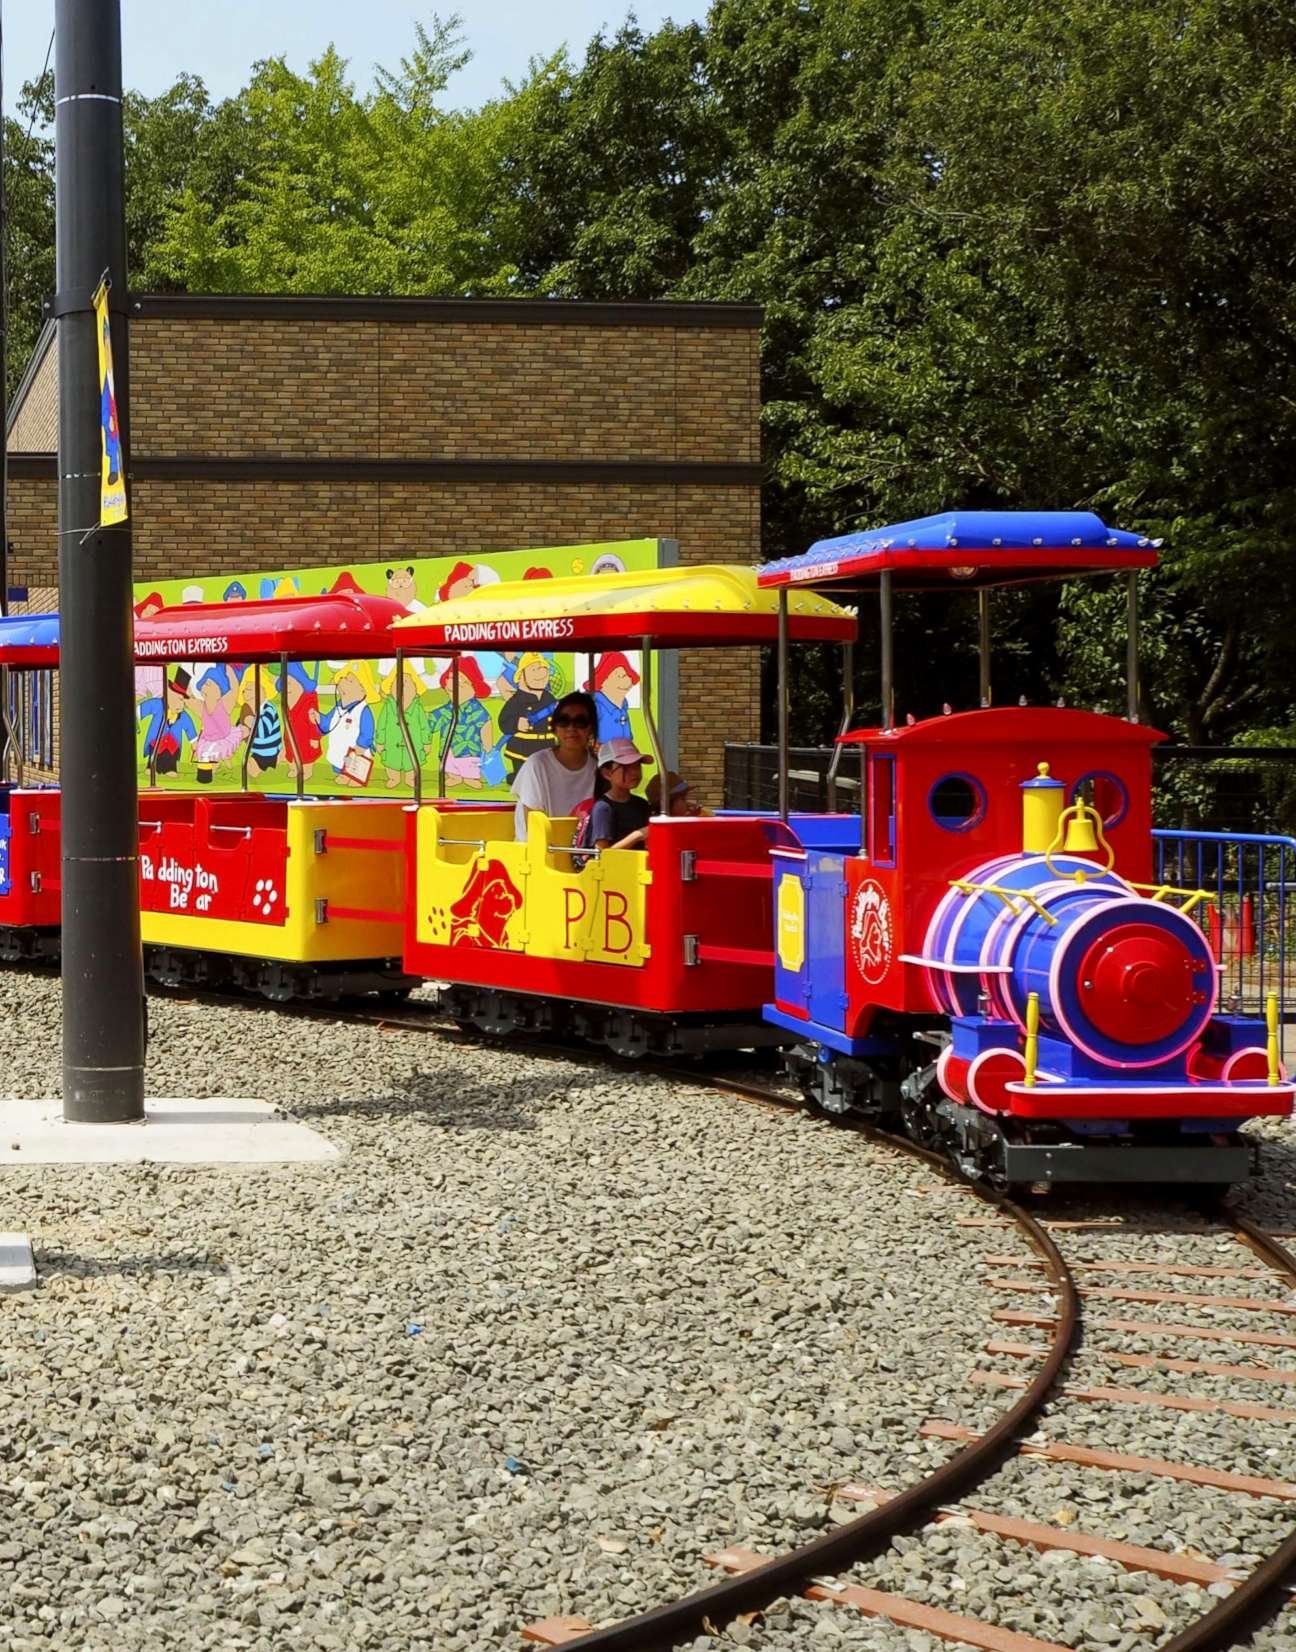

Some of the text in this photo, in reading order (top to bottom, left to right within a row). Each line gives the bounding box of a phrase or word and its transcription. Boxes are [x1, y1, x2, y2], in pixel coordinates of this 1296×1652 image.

[444, 618, 574, 642] PADDINGTON EXPRESS
[188, 636, 228, 654] EXPRESS
